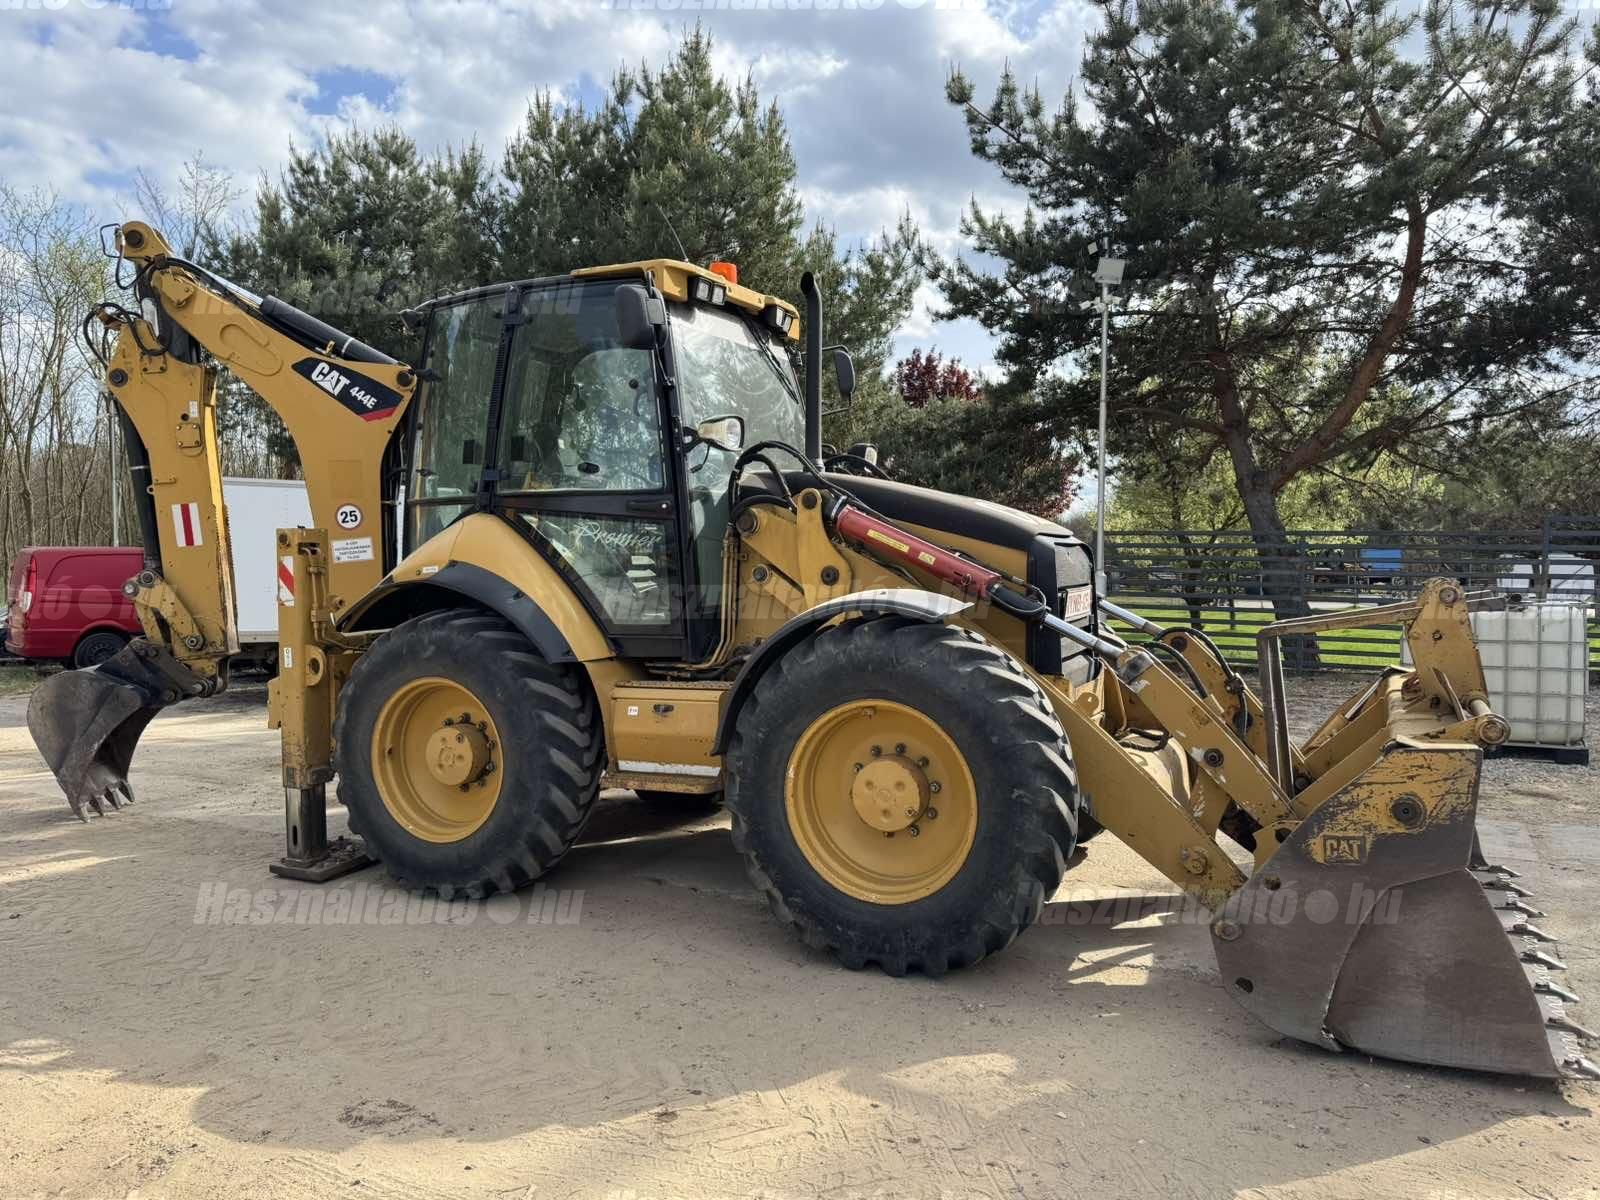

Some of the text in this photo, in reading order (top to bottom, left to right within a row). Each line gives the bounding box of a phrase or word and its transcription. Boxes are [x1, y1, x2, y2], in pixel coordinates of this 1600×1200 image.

[311, 362, 378, 409] CAT 444E
[340, 510, 358, 524] 25
[1326, 838, 1361, 863] CAT
